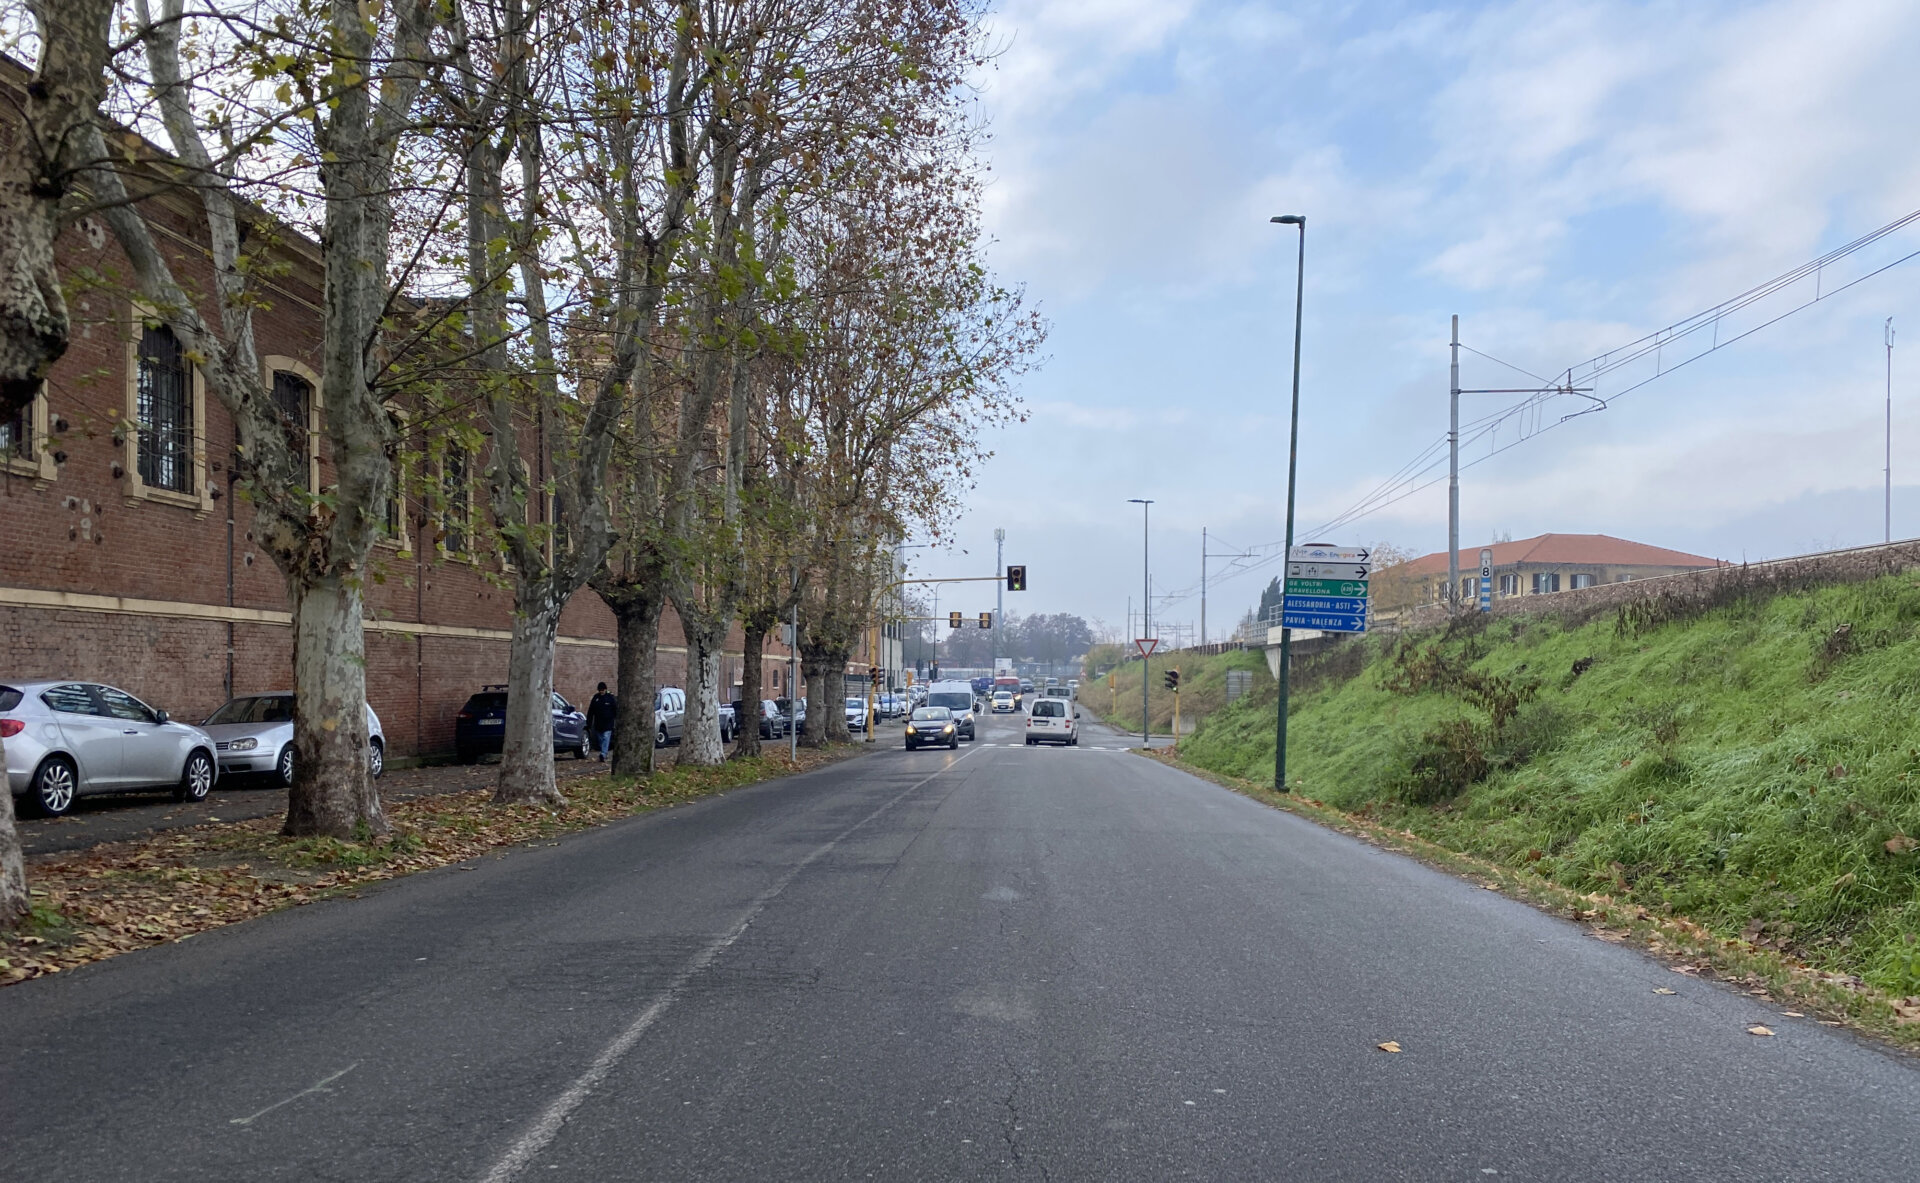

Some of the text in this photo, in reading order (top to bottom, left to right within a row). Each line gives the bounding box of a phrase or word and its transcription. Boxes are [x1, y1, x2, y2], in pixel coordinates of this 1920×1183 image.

[1482, 567, 1489, 576] 8
[1287, 600, 1330, 608] ALESSANDRIA
[1285, 616, 1305, 624] PAVIA
[1311, 617, 1342, 626] VALENZA
